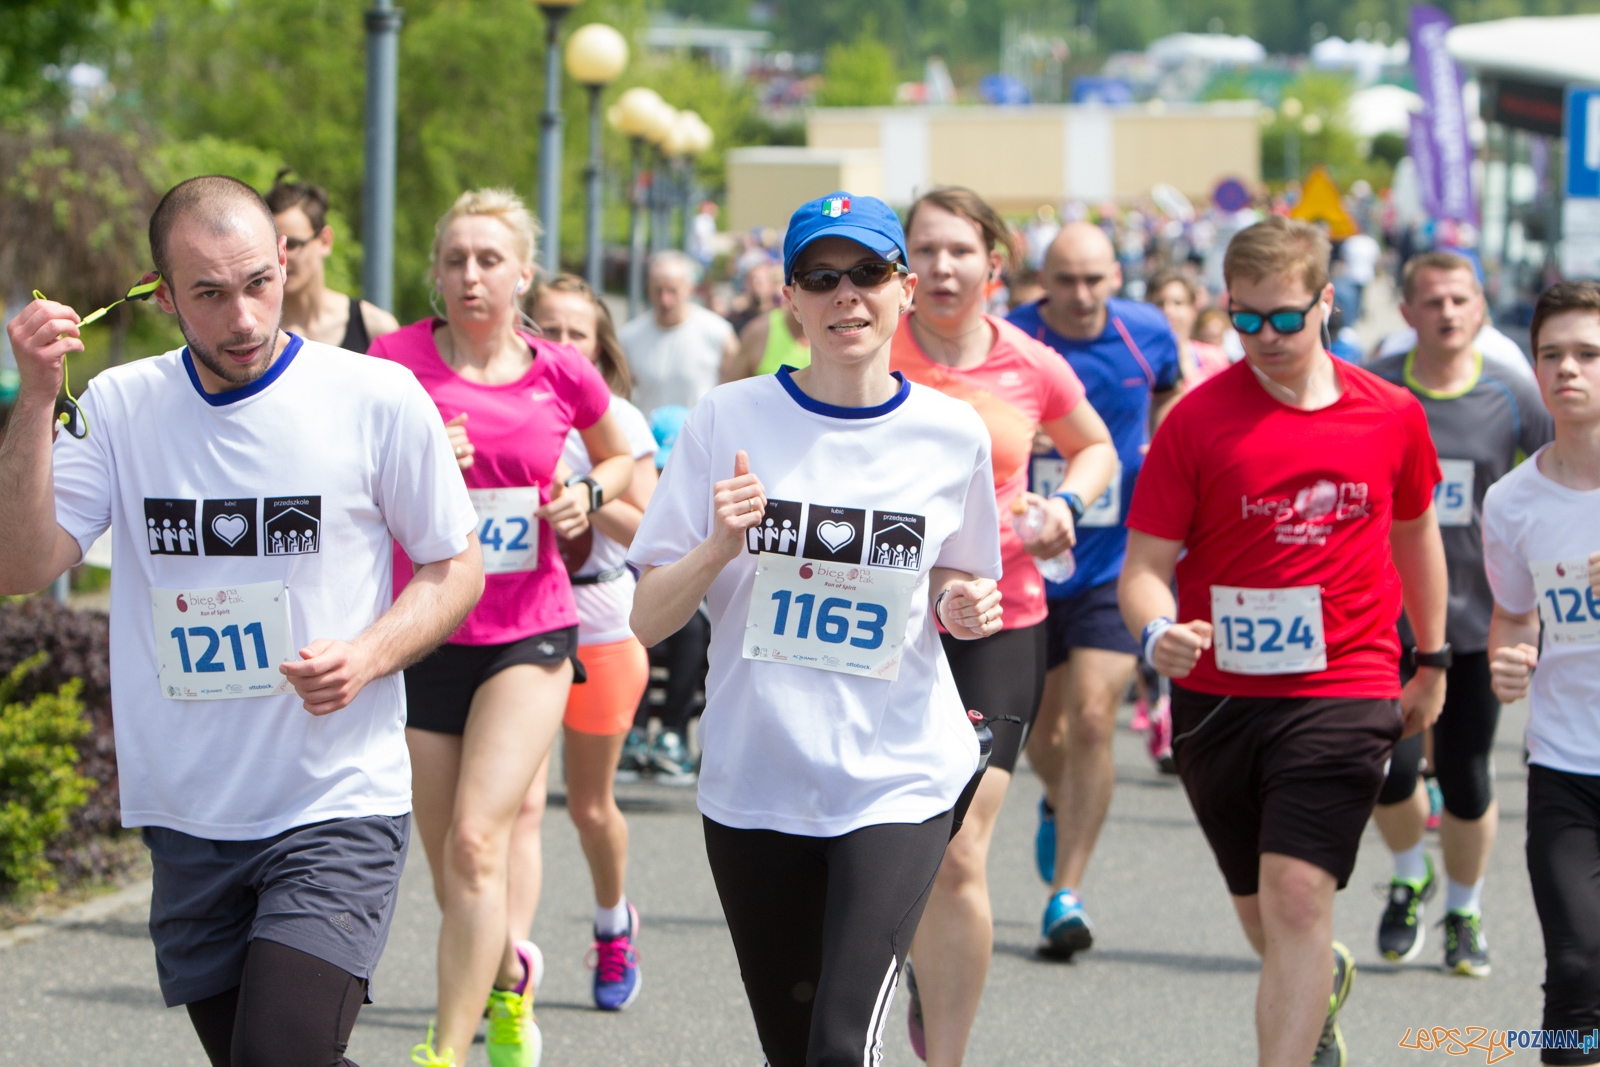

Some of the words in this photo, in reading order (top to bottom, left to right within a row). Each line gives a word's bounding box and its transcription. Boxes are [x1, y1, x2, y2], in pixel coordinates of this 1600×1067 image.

[273, 499, 310, 507] przedszkole
[883, 514, 917, 523] przedszkole
[817, 563, 845, 583] bieg
[859, 575, 874, 584] tak
[189, 592, 217, 610] bieg
[228, 595, 244, 604] tak
[217, 608, 231, 616] Spirit
[771, 589, 888, 650] 1163
[1221, 615, 1315, 653] 1324
[170, 622, 269, 673] 1211
